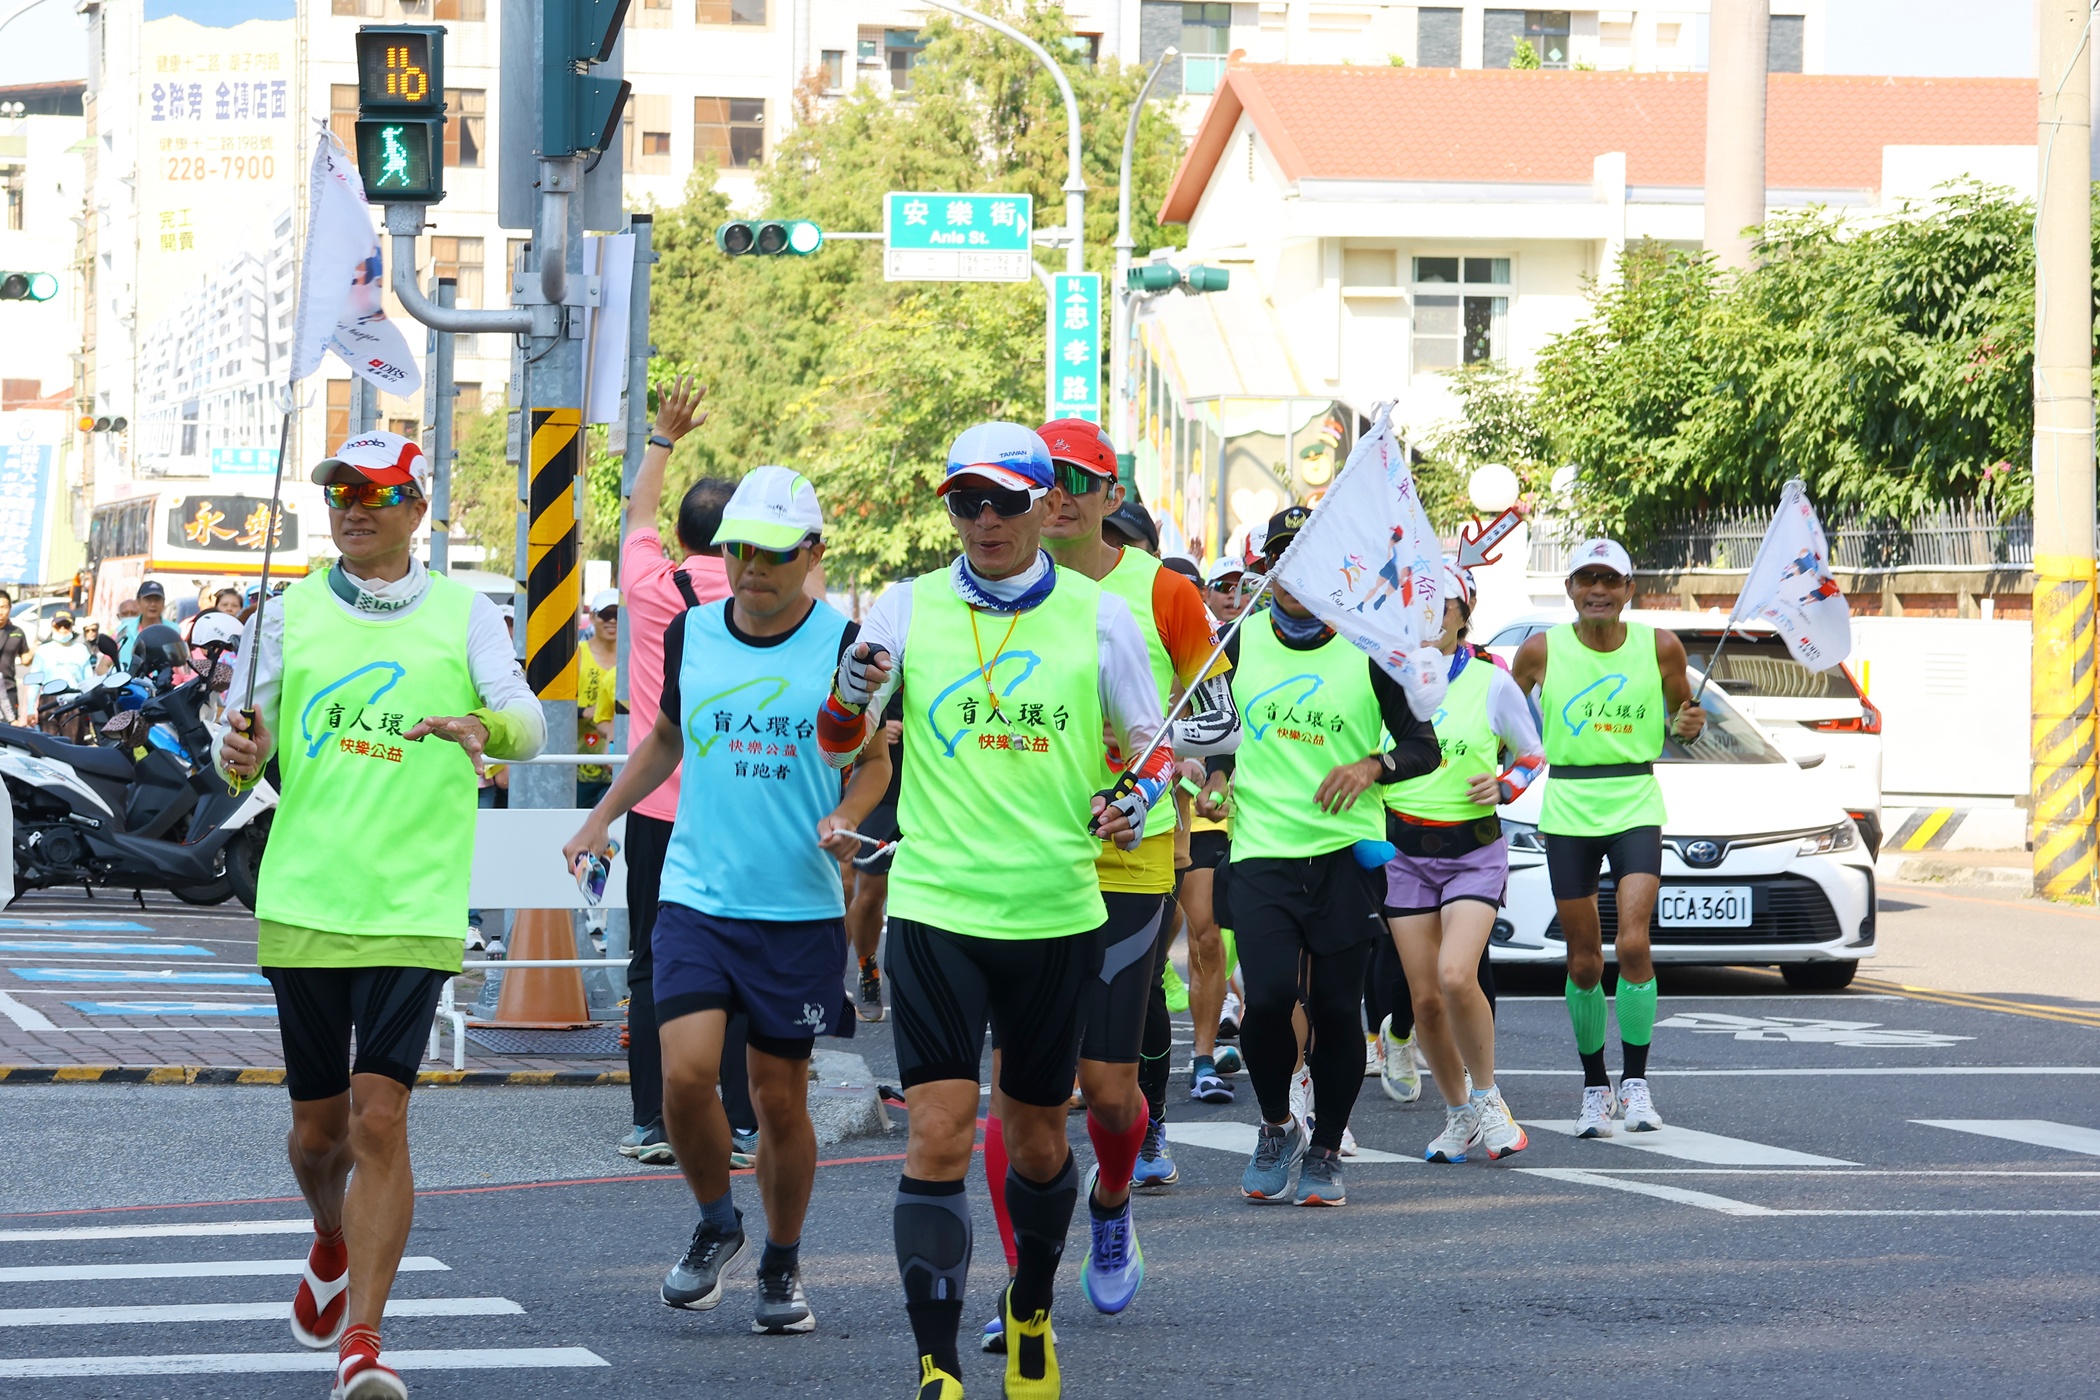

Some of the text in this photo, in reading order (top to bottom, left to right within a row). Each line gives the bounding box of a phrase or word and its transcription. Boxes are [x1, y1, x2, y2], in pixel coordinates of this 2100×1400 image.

[151, 80, 287, 121] 全聯旁 金磚店面
[167, 155, 275, 181] 228-7900
[159, 208, 193, 229] 完工
[903, 199, 1016, 227] 安樂街
[929, 229, 990, 245] Anle St.
[1068, 277, 1086, 293] N.
[1062, 303, 1090, 401] 忠孝路
[379, 363, 408, 379] DBS
[999, 450, 1028, 459] TAIWAN
[184, 500, 284, 551] 永樂
[957, 696, 1070, 732] 盲人環台
[1264, 702, 1345, 733] 盲人環台
[1581, 700, 1647, 720] 盲人環台
[713, 710, 815, 740] 盲人環台
[1593, 722, 1634, 734] 快樂公益
[728, 738, 798, 758] 快樂公益
[1276, 727, 1325, 747] 快樂公益
[340, 736, 404, 764] 快樂公益
[734, 760, 791, 781] 盲跑者
[1662, 896, 1746, 920] CCA-3601
